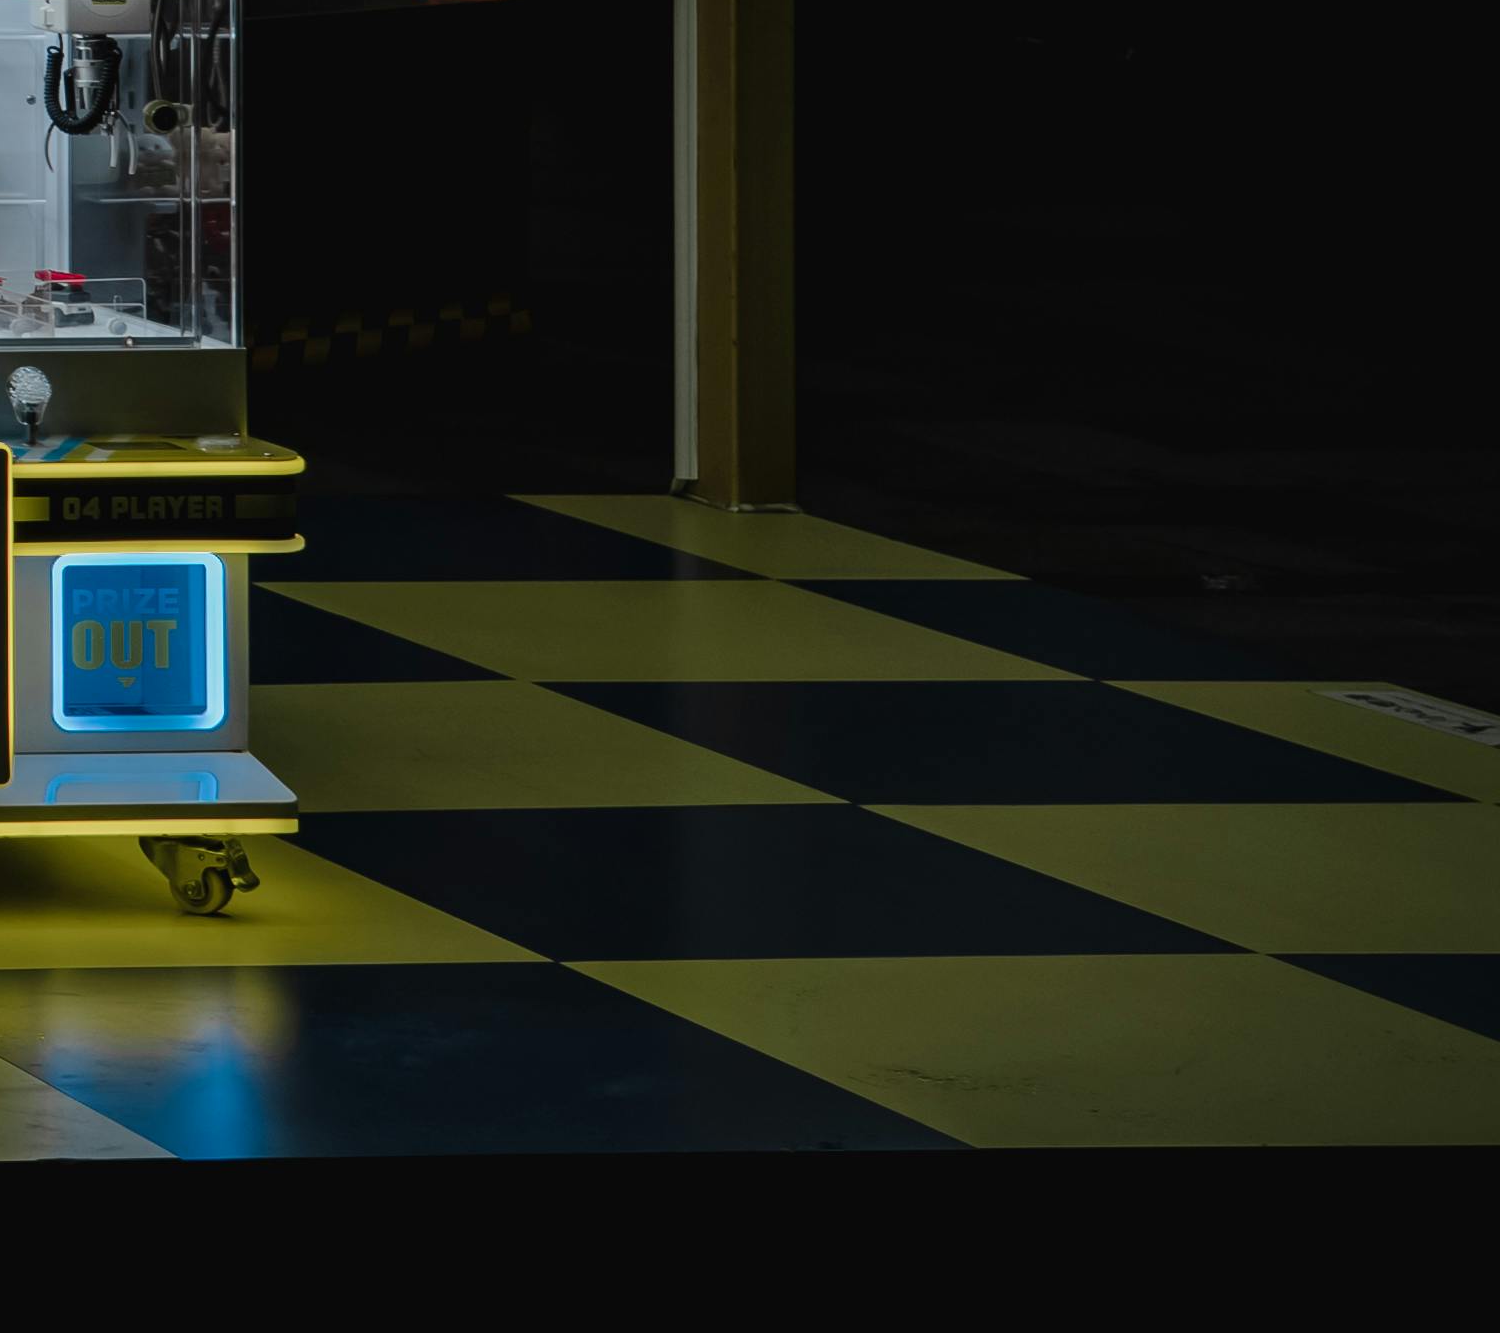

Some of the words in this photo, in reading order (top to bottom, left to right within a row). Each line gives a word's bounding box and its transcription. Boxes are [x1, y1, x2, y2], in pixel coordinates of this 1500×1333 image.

[61, 495, 101, 521] 04
[110, 495, 224, 520] PLAYER
[71, 619, 179, 670] OUT
